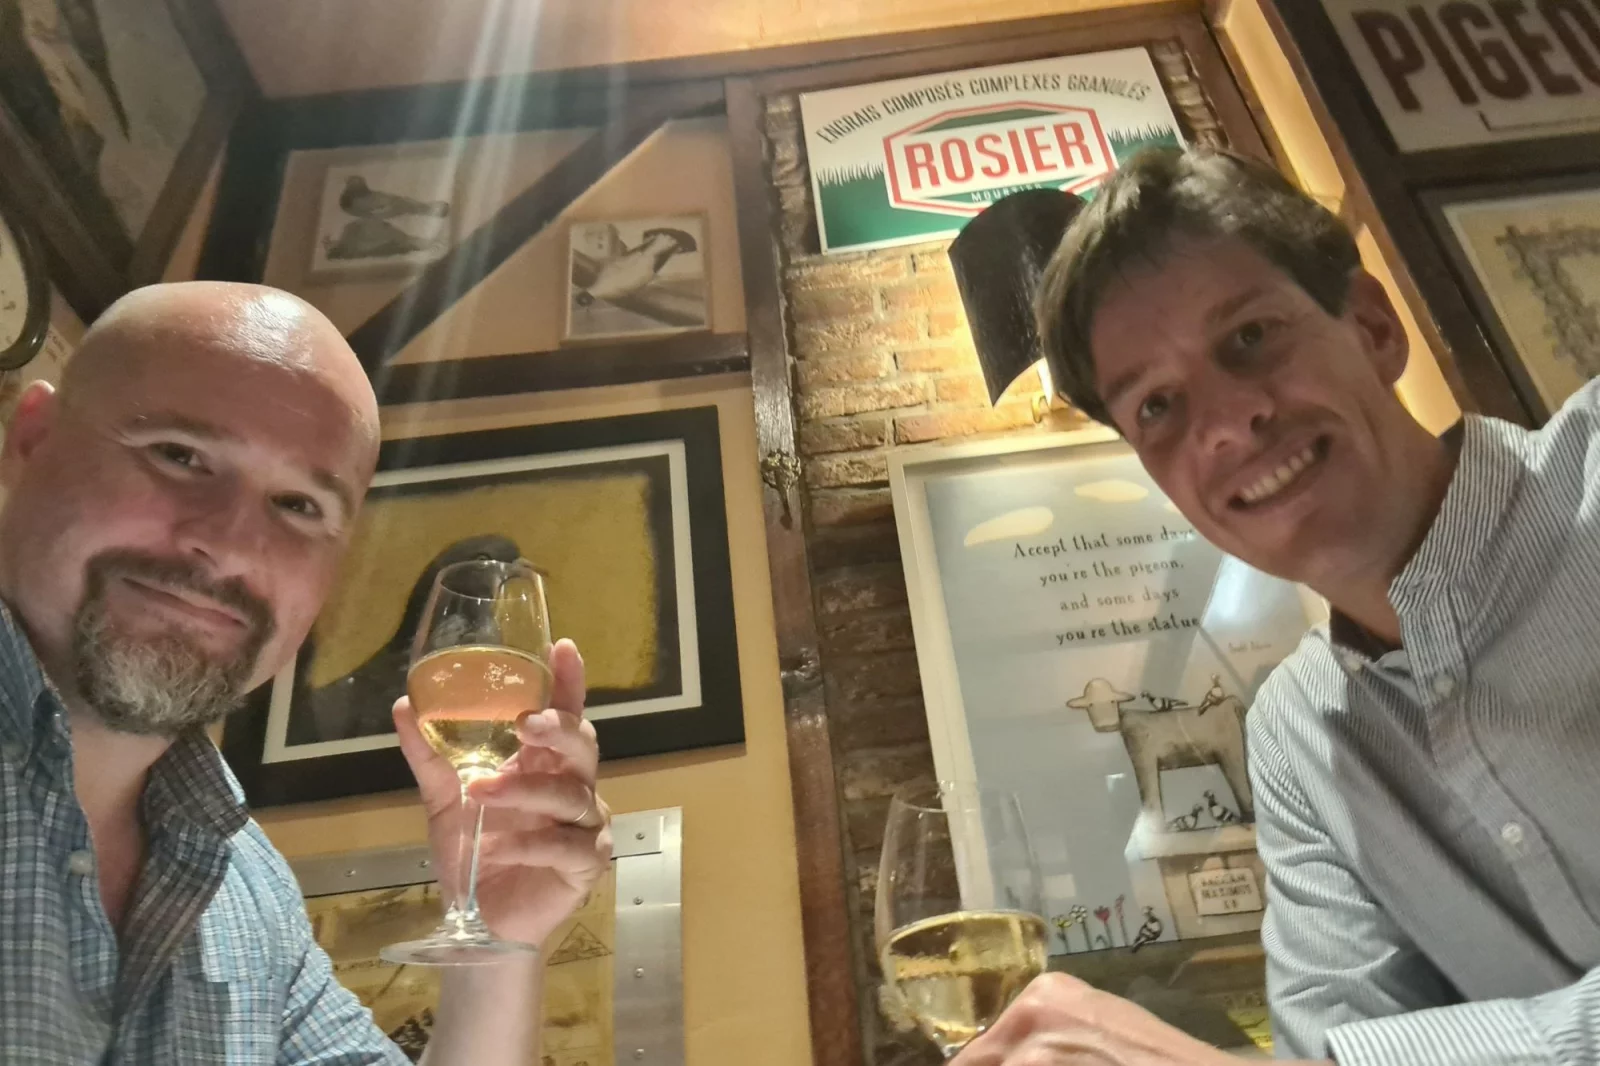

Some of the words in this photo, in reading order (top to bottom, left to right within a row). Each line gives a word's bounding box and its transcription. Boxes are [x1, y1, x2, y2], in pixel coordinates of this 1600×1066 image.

[1352, 0, 1600, 112] PIGEO
[816, 103, 881, 144] ENGRAIS
[881, 80, 964, 116] COMPOSÉS
[969, 73, 1061, 96] COMPLEXES
[1067, 74, 1151, 101] GRANULÉS
[903, 121, 1094, 191] ROSIER
[1014, 538, 1067, 558] Accept
[1072, 533, 1109, 551] that
[1116, 534, 1153, 546] some
[1040, 563, 1088, 587] you're
[1092, 561, 1121, 578] the
[1060, 592, 1089, 610] and
[1097, 595, 1135, 606] some
[1111, 618, 1142, 636] the
